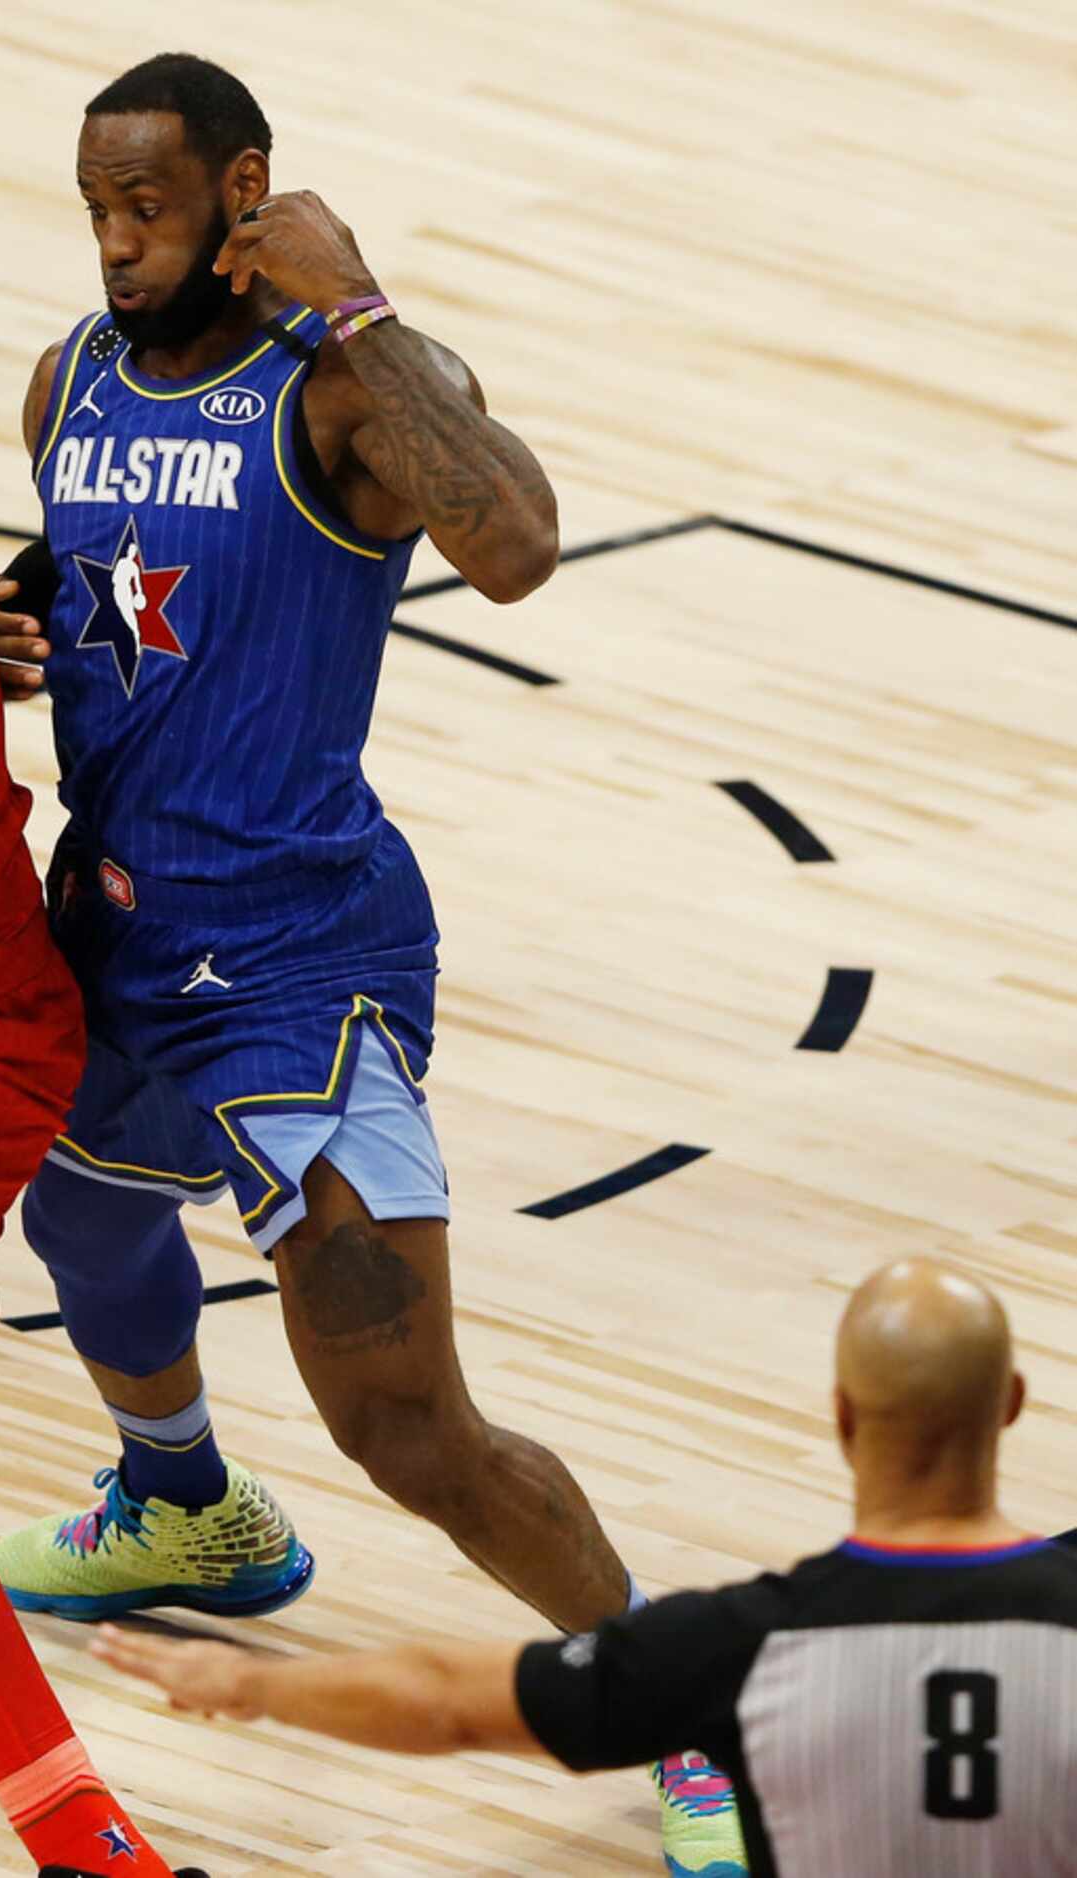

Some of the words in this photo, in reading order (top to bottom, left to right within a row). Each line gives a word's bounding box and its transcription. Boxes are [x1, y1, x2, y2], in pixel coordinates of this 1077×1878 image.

[209, 394, 253, 418] KIA
[51, 435, 244, 512] ALL-STAR
[925, 1669, 999, 1821] 8
